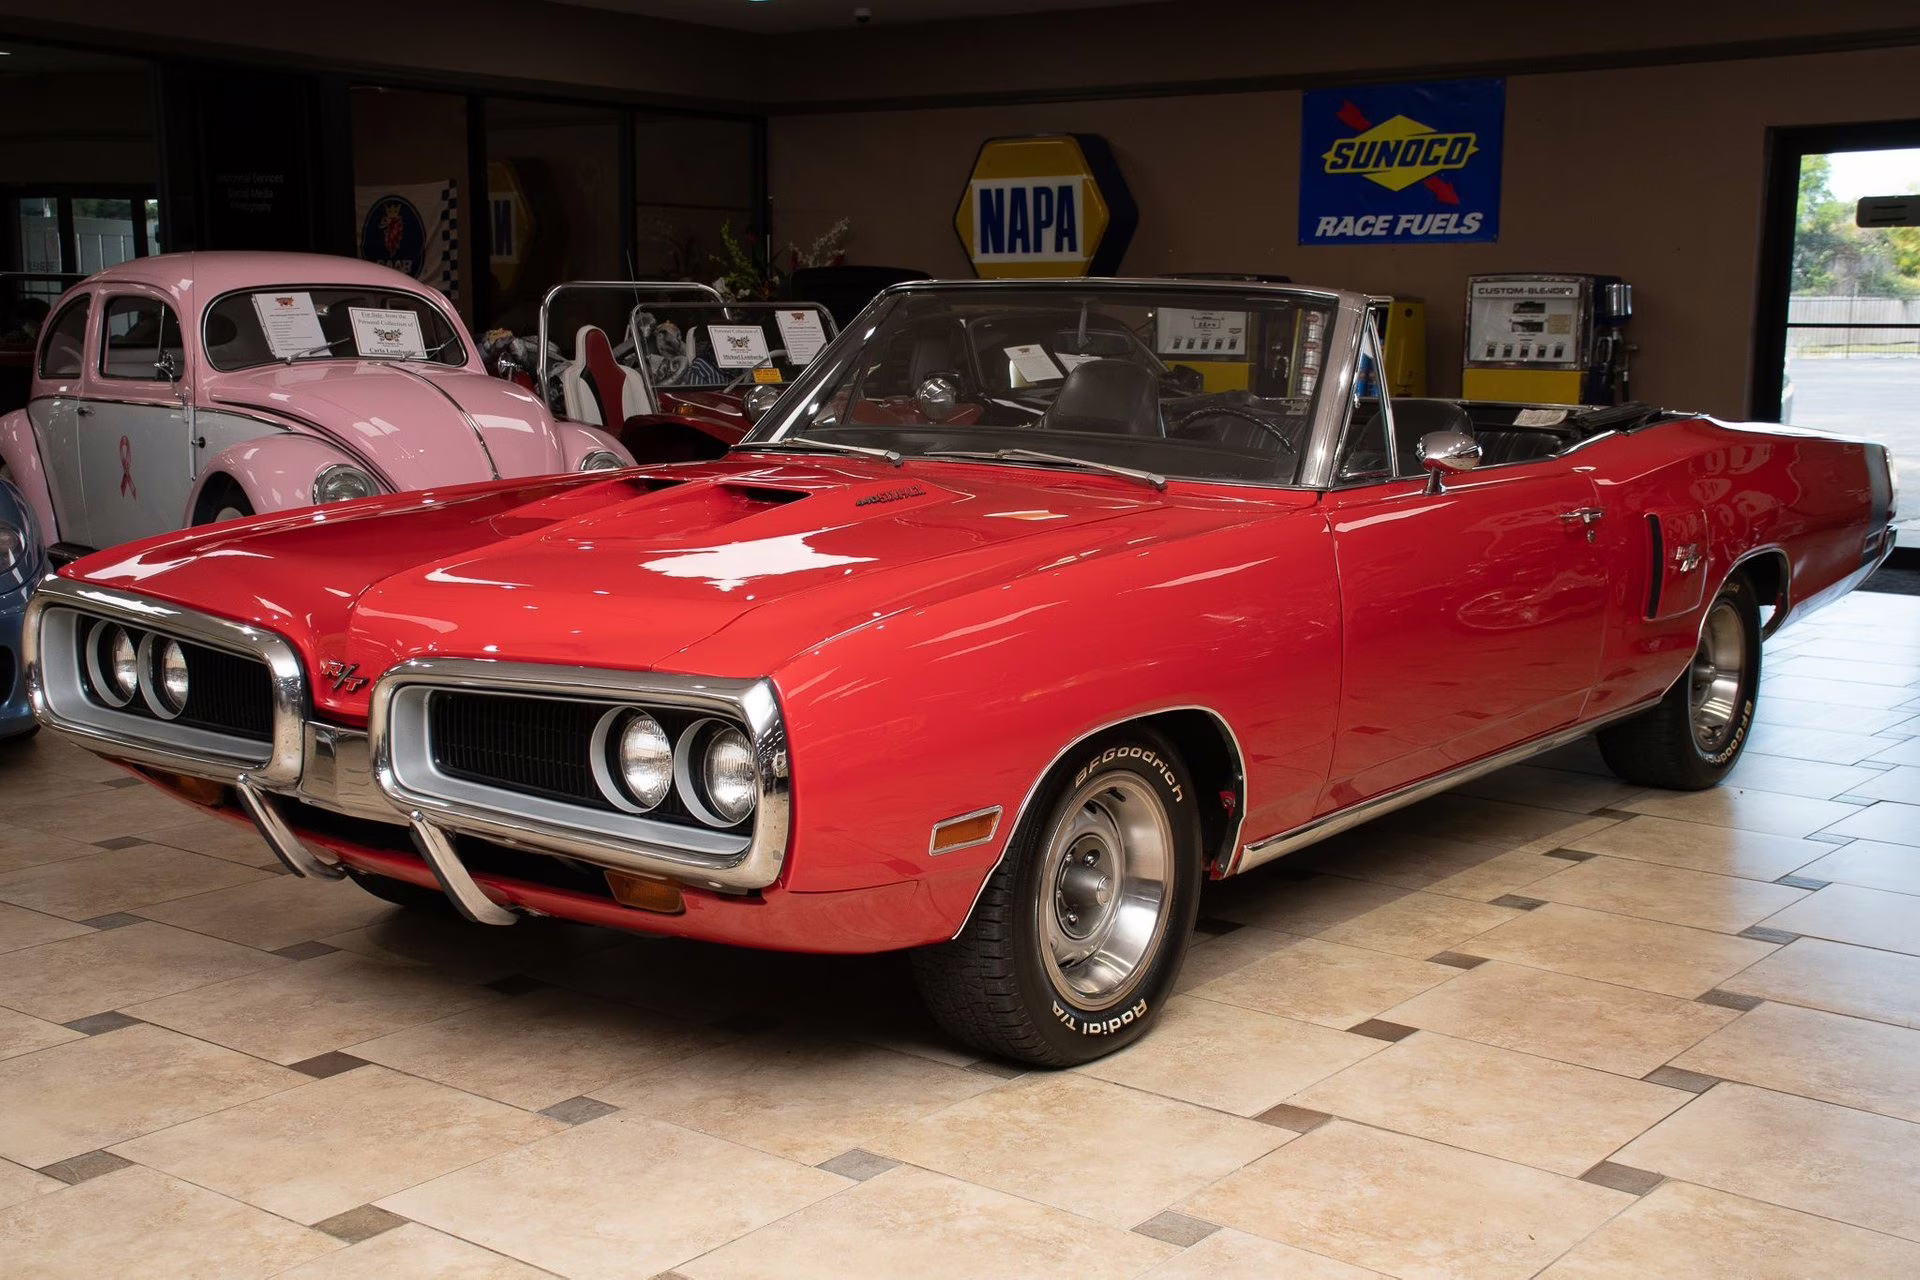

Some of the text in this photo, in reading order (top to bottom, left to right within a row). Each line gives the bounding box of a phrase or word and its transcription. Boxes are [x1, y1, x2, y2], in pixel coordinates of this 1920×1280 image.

[1329, 137, 1472, 170] SUNOCO
[979, 185, 1077, 254] NAPA
[1315, 212, 1483, 236] RACE FUELS
[321, 660, 365, 692] R/T
[1075, 747, 1183, 802] BFGoodrich
[1083, 998, 1147, 1035] Radial
